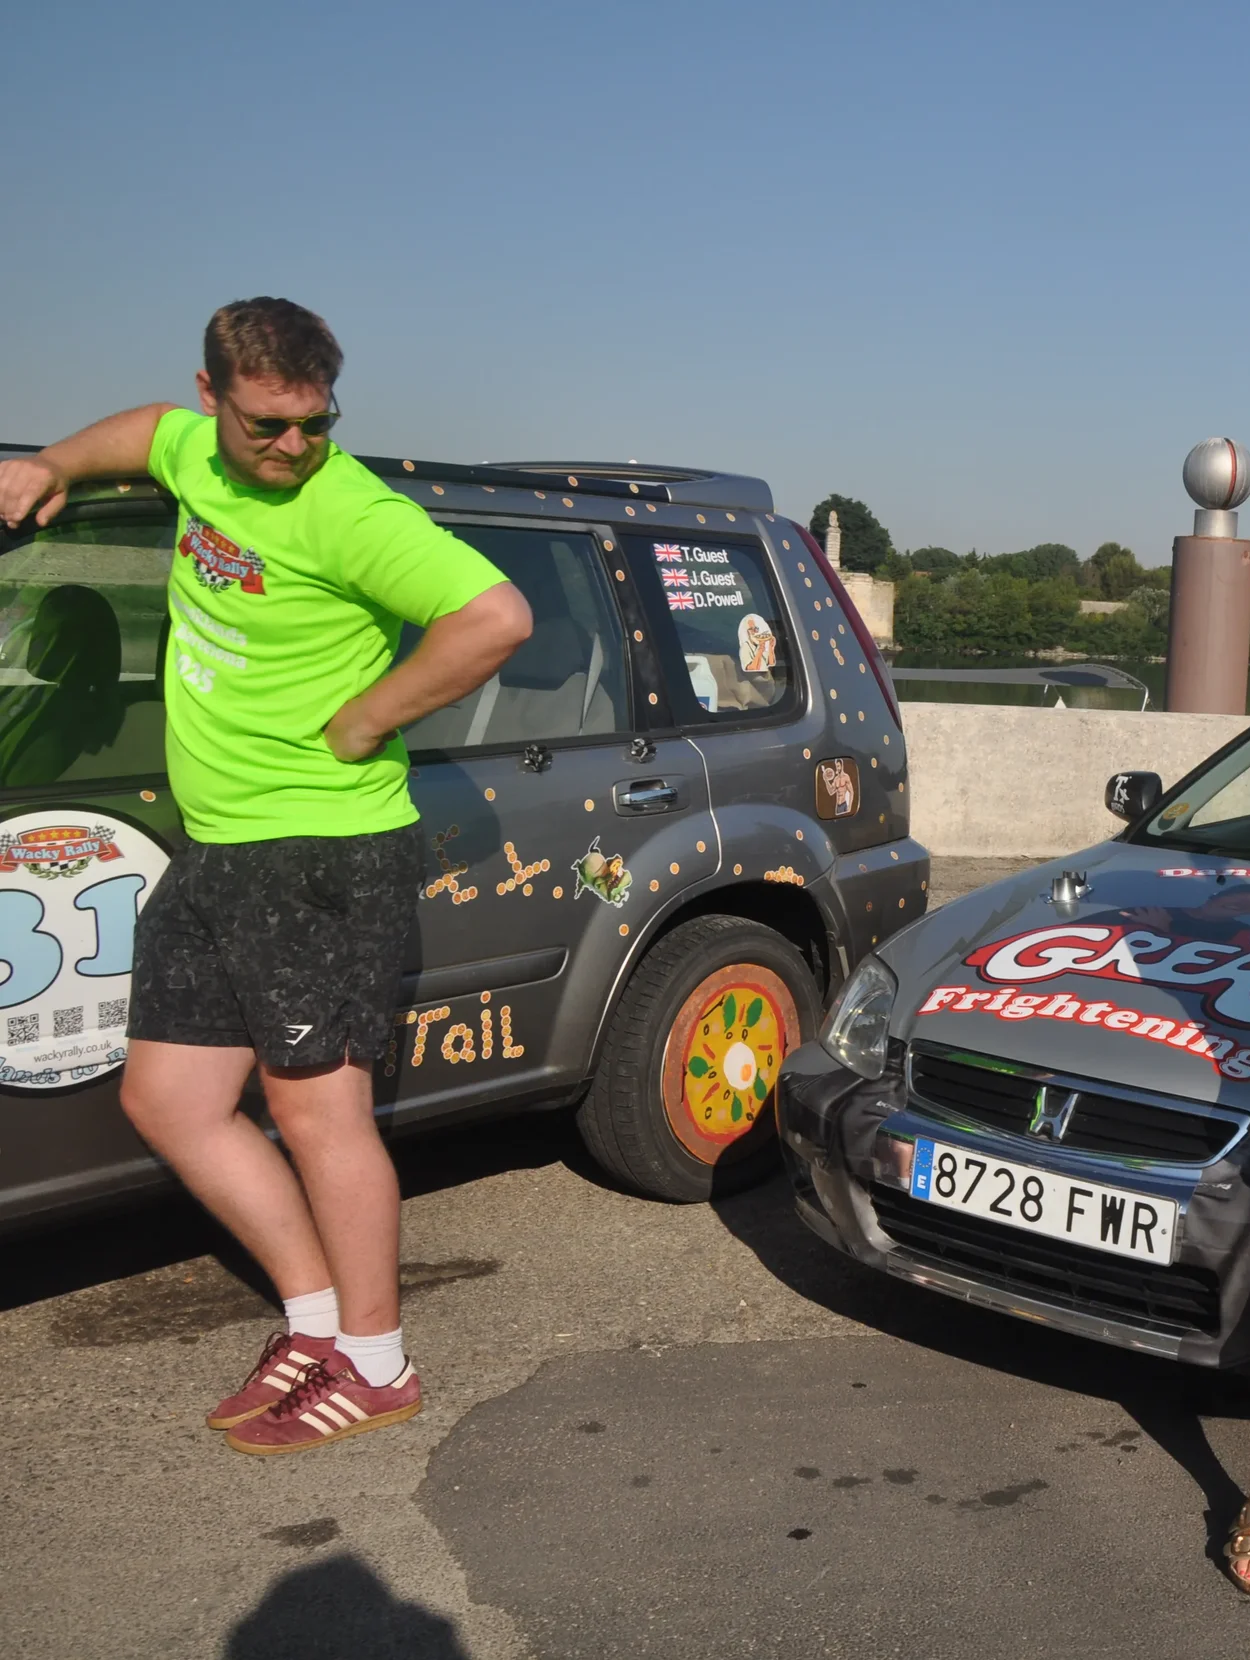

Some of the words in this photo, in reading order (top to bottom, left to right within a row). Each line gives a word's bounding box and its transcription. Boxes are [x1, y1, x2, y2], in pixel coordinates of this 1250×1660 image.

[680, 546, 730, 563] T.Guest
[690, 570, 737, 586] J.Guest
[693, 590, 744, 608] D.Powell
[11, 847, 60, 860] Wacky
[64, 840, 101, 857] Rally
[33, 1039, 113, 1063] wackyrally.co.uk
[917, 1174, 927, 1189] E
[934, 1151, 1045, 1223] 8728
[1065, 1185, 1159, 1254] FWR
